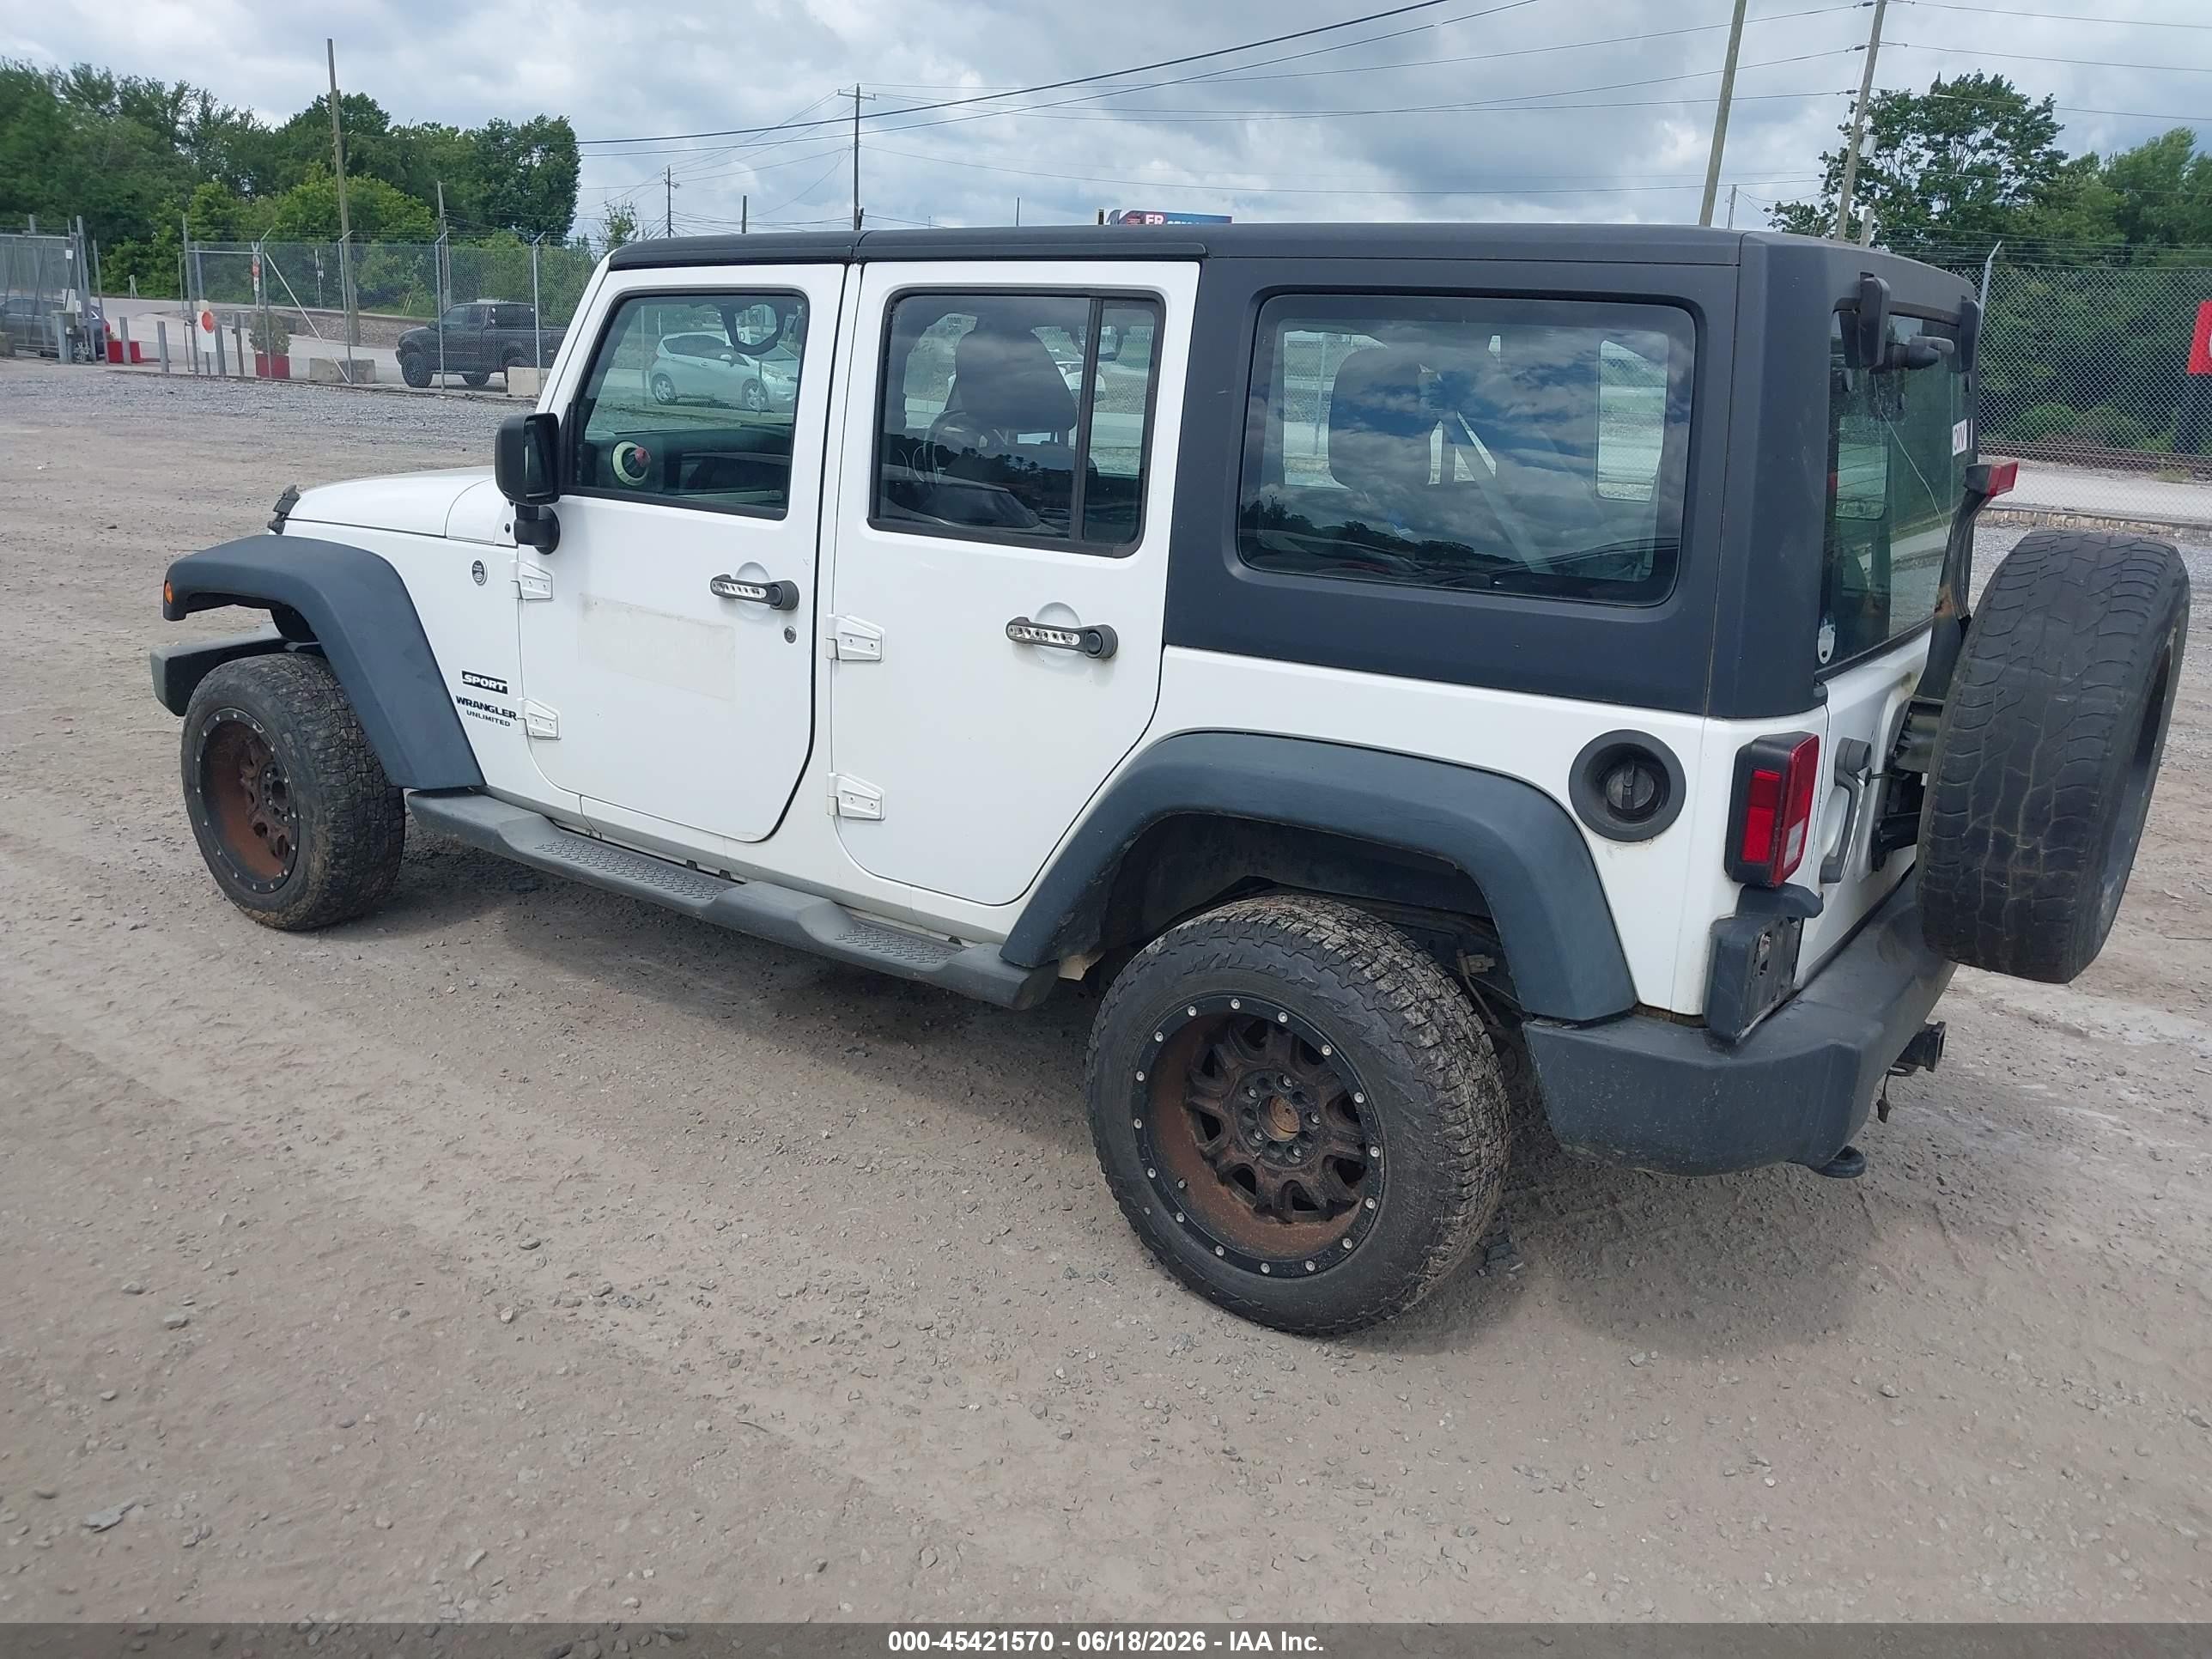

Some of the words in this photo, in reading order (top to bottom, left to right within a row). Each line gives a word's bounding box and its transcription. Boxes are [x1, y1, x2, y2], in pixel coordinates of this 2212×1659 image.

[463, 674, 508, 691] SPORT
[456, 696, 517, 720] WRANGLER
[466, 711, 511, 726] UNLIMITED
